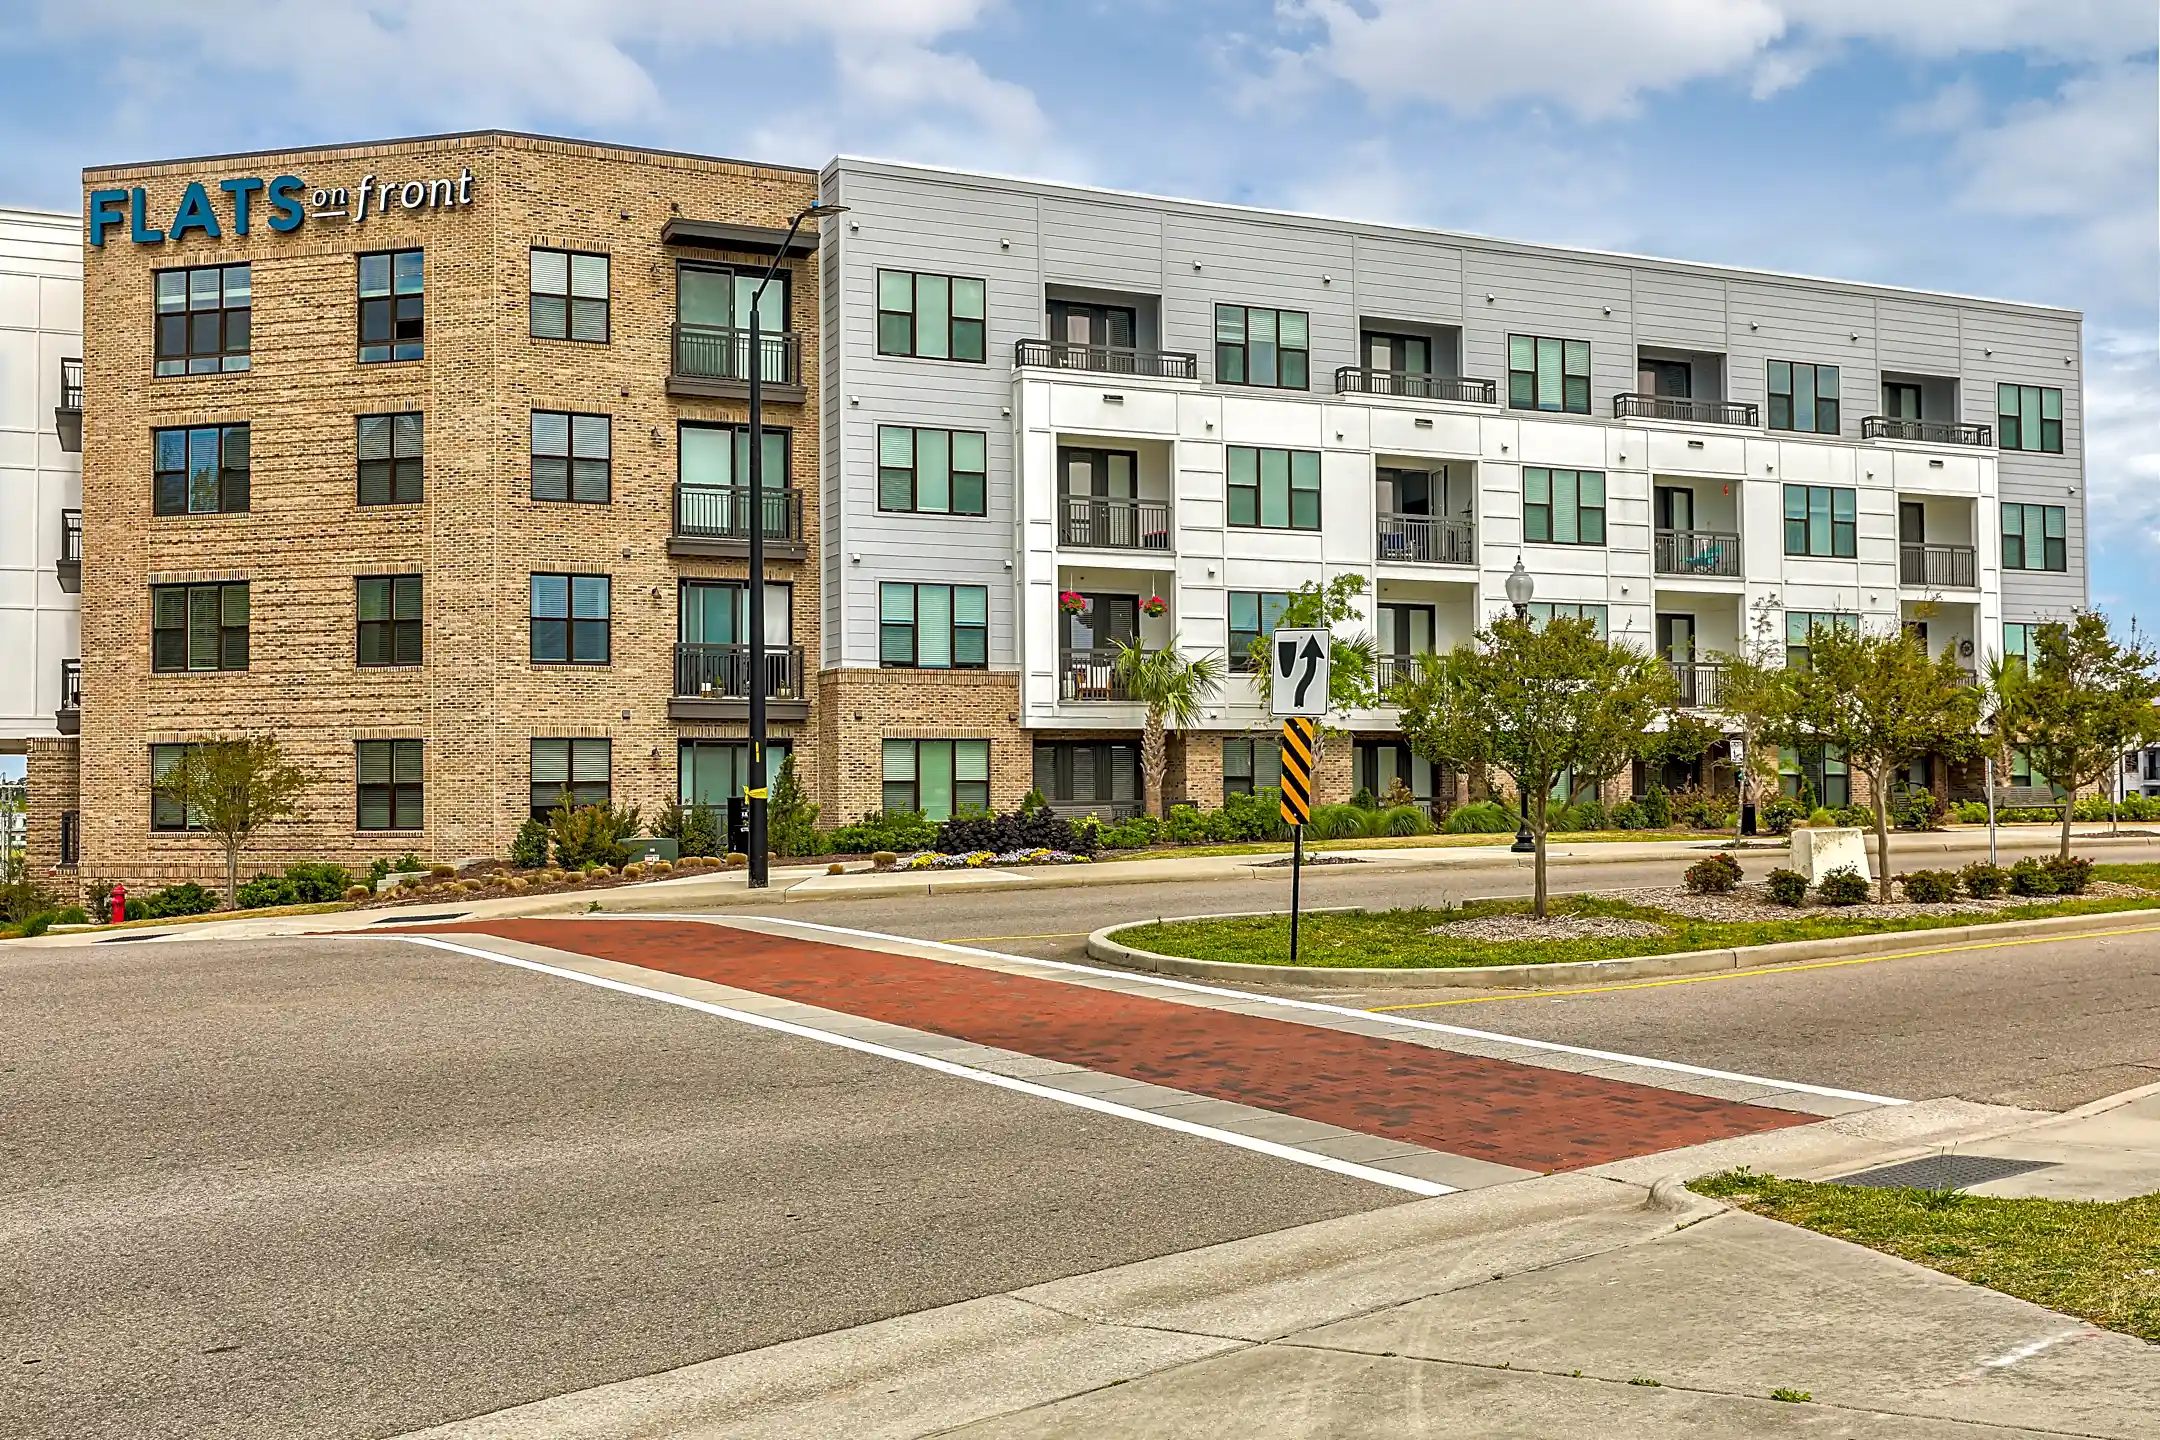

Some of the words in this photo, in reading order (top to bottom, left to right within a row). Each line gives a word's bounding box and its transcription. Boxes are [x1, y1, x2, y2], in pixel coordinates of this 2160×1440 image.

[90, 174, 306, 247] FLATS
[312, 187, 348, 208] on
[352, 168, 475, 223] front
